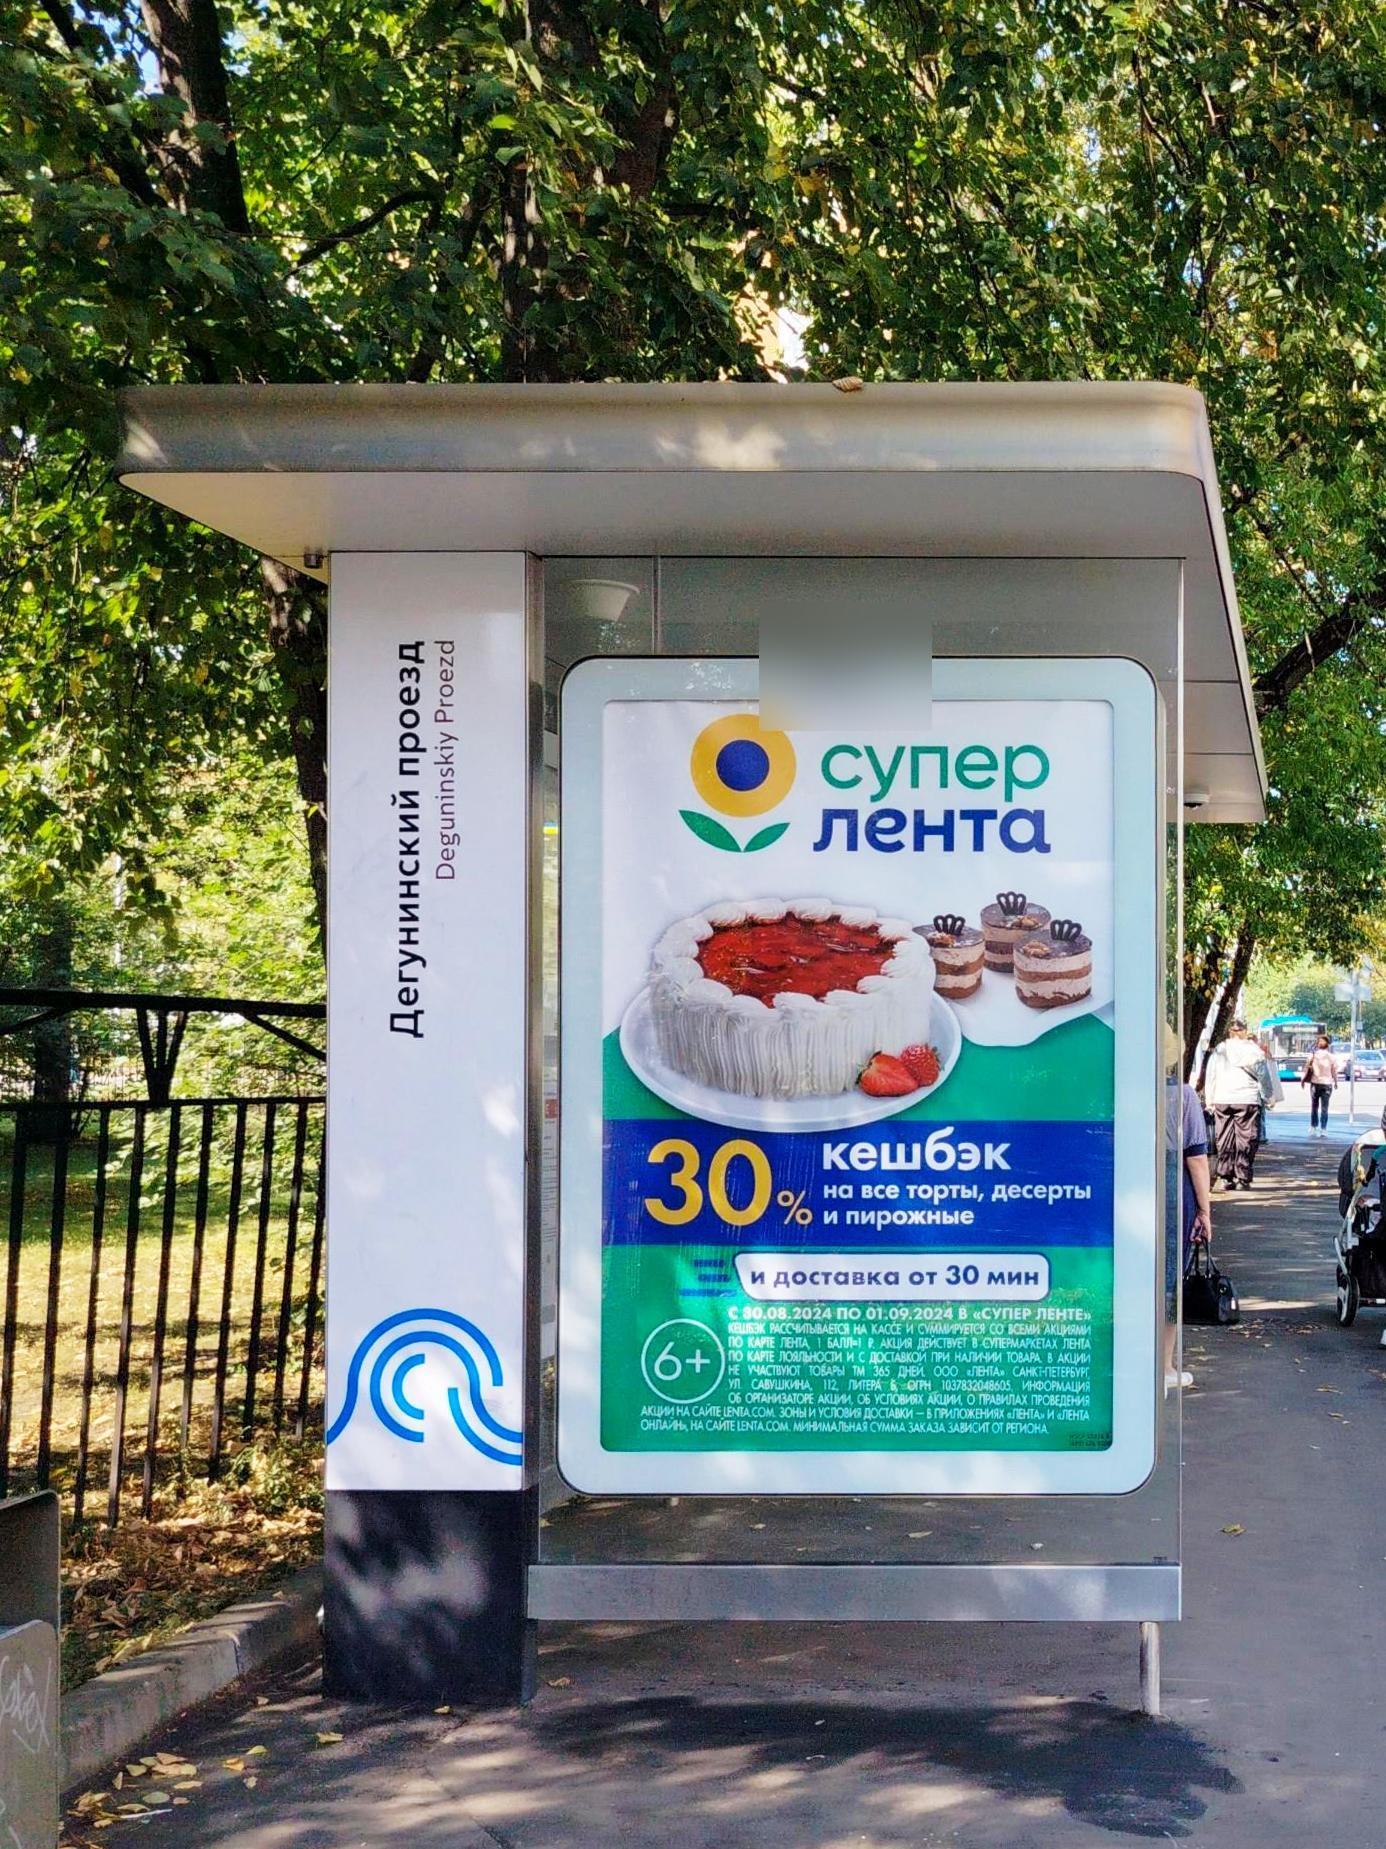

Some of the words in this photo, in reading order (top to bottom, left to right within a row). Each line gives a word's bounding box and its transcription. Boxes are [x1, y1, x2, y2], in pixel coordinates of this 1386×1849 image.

[434, 639, 456, 723] Proezd
[397, 640, 427, 776] проезд
[820, 744, 1050, 802] супер
[434, 732, 461, 881] Deguninskiy
[813, 807, 1051, 853] лента
[390, 791, 427, 1039] Дегунинский
[822, 1126, 1012, 1171] кешбэк
[824, 1184, 854, 1200] на
[861, 1184, 899, 1200] все
[905, 1184, 984, 1203] торты,
[991, 1184, 1092, 1203] десерты
[824, 1210, 838, 1225] и
[846, 1209, 974, 1230] пирожные
[751, 1271, 765, 1286] и
[773, 1269, 900, 1289] доставка
[909, 1270, 938, 1286] от
[946, 1266, 979, 1286] 30
[987, 1269, 1040, 1286] мин
[728, 1306, 739, 1320] С
[836, 1307, 861, 1320] ПО
[866, 1307, 953, 1320] 01.09.2024
[958, 1308, 968, 1320] В
[973, 1307, 1032, 1321] «СУПЕР
[1036, 1308, 1092, 1321] ЛЕНТЕ»
[728, 1322, 766, 1334] КЕШБЭК
[770, 1322, 849, 1335] РАССЧИТЫВАЕТСЯ
[854, 1323, 867, 1335] НА
[872, 1323, 902, 1335] КАССЕ
[906, 1324, 914, 1335] И
[918, 1323, 985, 1335] СУММИРУЕТСЯ
[990, 1324, 1004, 1335] СО
[1008, 1324, 1040, 1336] ВСЕМИ
[1044, 1325, 1091, 1337] АКЦИЯМИ
[728, 1336, 743, 1348] ПО
[748, 1336, 775, 1349] КАРТЕ
[881, 1338, 912, 1351] АКЦИЯ
[917, 1336, 967, 1351] ДЕЙСТВУЕТ
[972, 1338, 978, 1350] В
[983, 1338, 1058, 1350] СУПЕРМАРКЕТАХ
[1062, 1339, 1091, 1350] ЛЕНТА
[654, 1341, 711, 1381] 6+
[728, 1351, 743, 1362] ПО
[747, 1351, 775, 1362] КАРТЕ
[779, 1351, 842, 1363] ЛОЯЛЬНОСТИ
[847, 1352, 854, 1362] И
[859, 1352, 865, 1363] С
[870, 1350, 927, 1364] ДОСТАВКОЙ
[931, 1352, 950, 1363] ПРИ
[954, 1352, 1002, 1363] НАЛИЧИИ
[1047, 1353, 1053, 1363] В
[1057, 1353, 1091, 1365] АКЦИИ
[728, 1365, 740, 1376] НЕ
[747, 1365, 801, 1376] УЧАСТВУЮТ
[809, 1365, 845, 1377] ТОВАРЫ
[852, 1366, 865, 1376] ТМ
[873, 1366, 890, 1377] 365
[933, 1366, 959, 1377] ООО
[966, 1366, 1005, 1377] «ЛЕНТА»
[848, 1379, 881, 1391] ЛИТЕРА
[907, 1380, 932, 1391] ОГРН
[1022, 1381, 1090, 1394] ИНФОРМАЦИЯ
[728, 1392, 742, 1404] ОБ
[745, 1393, 814, 1404] ОРГАНИЗАТОРЕ
[857, 1394, 871, 1405] ОБ
[875, 1394, 924, 1405] УСЛОВИЯХ
[967, 1395, 975, 1405] О
[979, 1394, 1027, 1406] ПРАВИЛАХ
[1031, 1395, 1090, 1407] ПРОВЕДЕНИЯ
[640, 1405, 674, 1418] АКЦИИ
[676, 1406, 690, 1417] НА
[692, 1403, 722, 1417] САЙТЕ
[780, 1407, 807, 1418] ЗОНЫ
[809, 1407, 816, 1418] И
[818, 1407, 862, 1418] УСЛОВИЯ
[863, 1408, 913, 1420] ДОСТАВКИ
[934, 1408, 1004, 1419] ПРИЛОЖЕНИЯХ
[1047, 1409, 1055, 1420] И
[690, 1420, 704, 1431] НА
[705, 1417, 735, 1431] САЙТЕ
[793, 1421, 868, 1432] МИНИМАЛЬНАЯ
[870, 1421, 906, 1433] СУММА
[908, 1422, 946, 1433] ЗАКАЗА
[948, 1422, 990, 1433] ЗАВИСИТ
[991, 1422, 1004, 1433] ОТ
